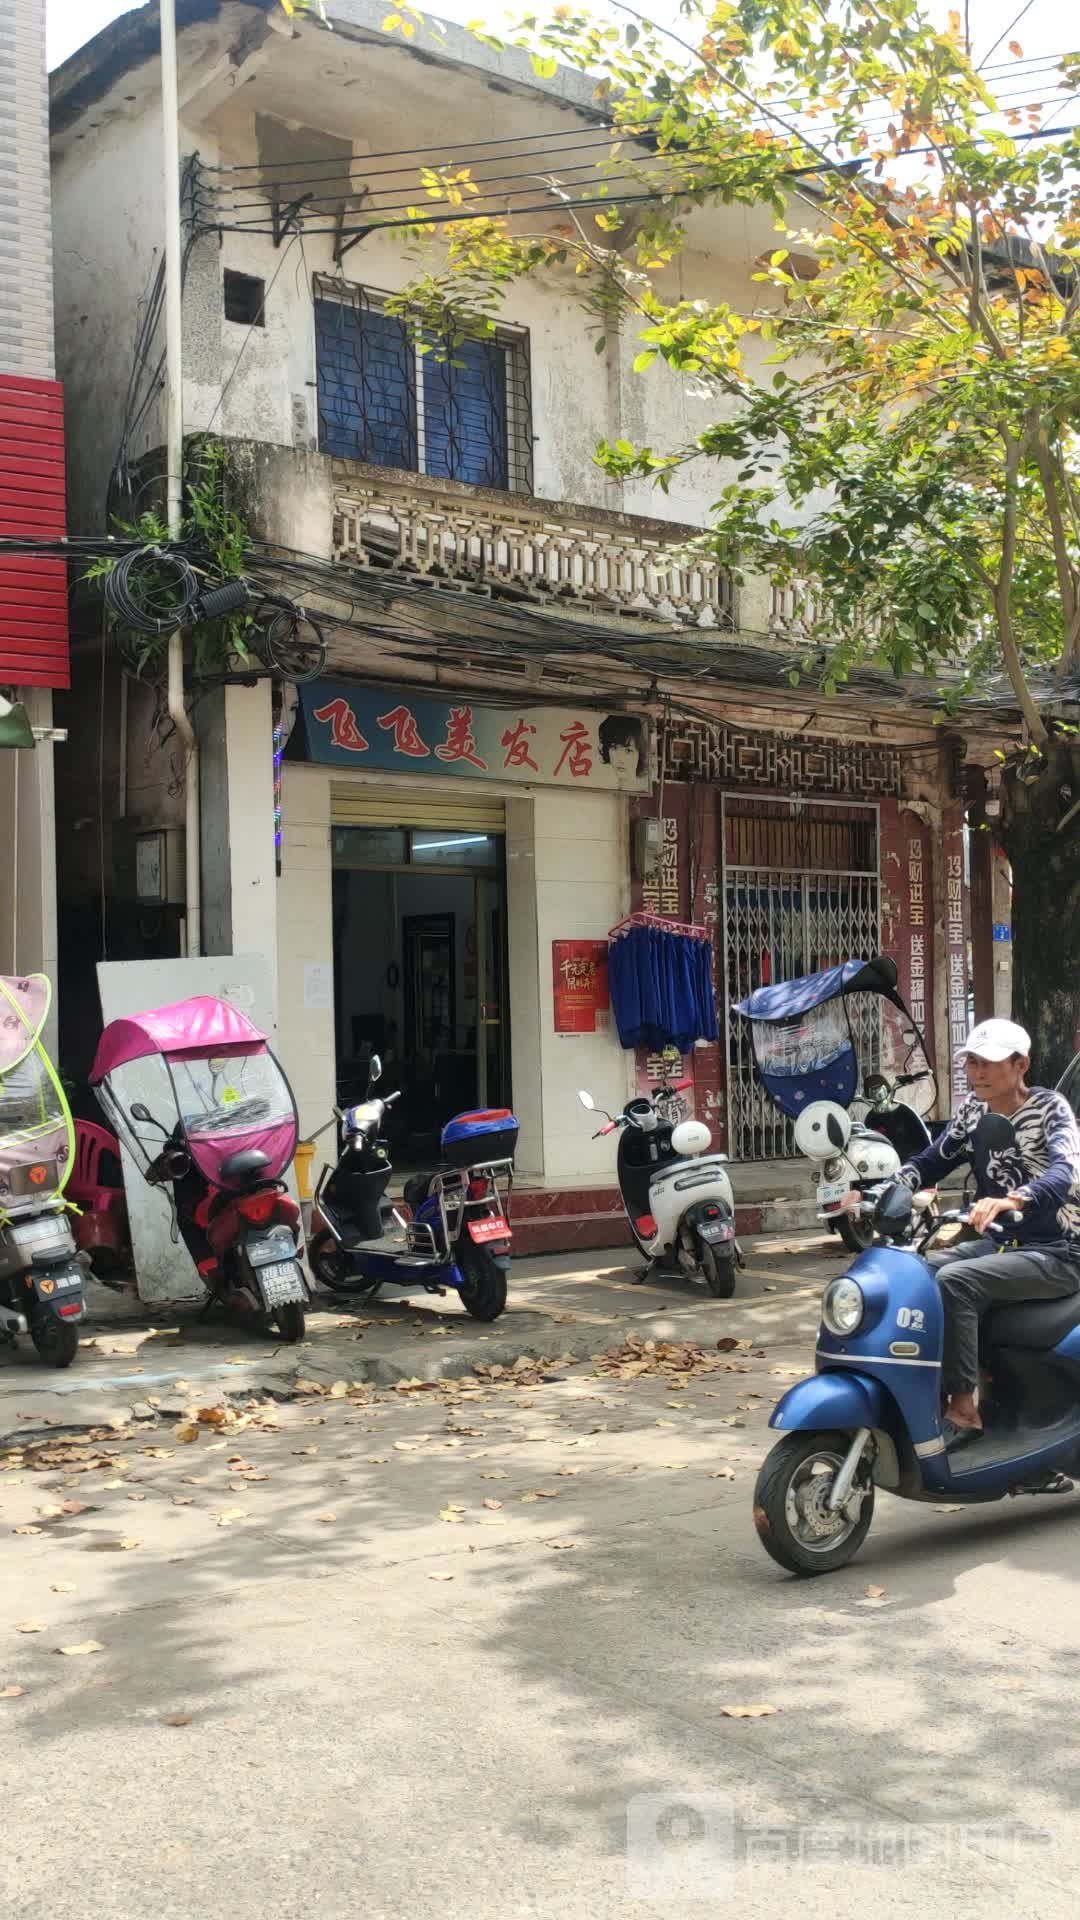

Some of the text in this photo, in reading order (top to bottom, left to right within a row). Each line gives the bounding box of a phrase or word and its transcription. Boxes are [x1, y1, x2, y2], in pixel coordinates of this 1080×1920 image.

[313, 697, 593, 777] 飞飞美发店
